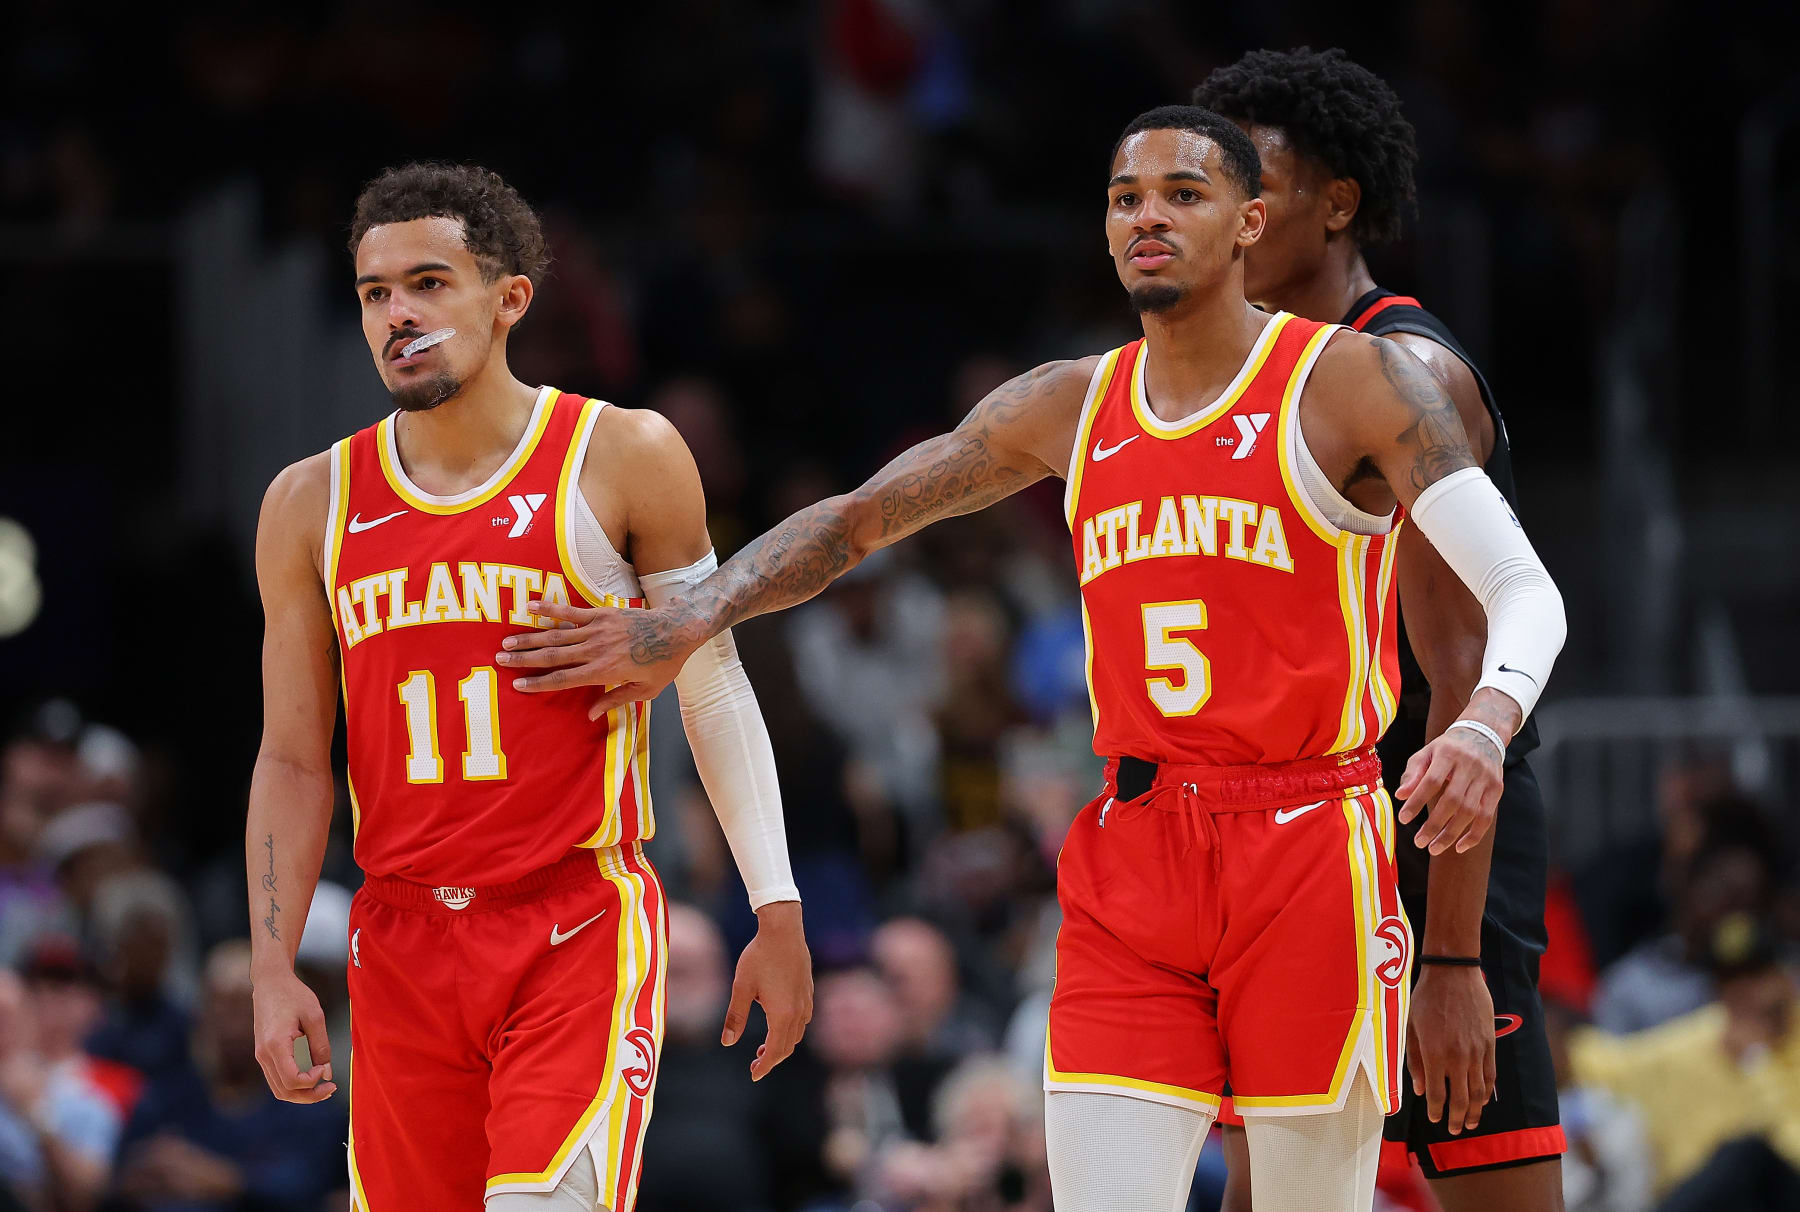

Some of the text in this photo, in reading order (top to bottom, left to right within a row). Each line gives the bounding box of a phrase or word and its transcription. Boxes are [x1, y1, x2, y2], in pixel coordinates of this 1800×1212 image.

[1215, 412, 1271, 460] the Y
[491, 493, 548, 538] the Y
[1080, 495, 1295, 588] ATLANTA
[1141, 599, 1212, 718] 5
[397, 665, 508, 785] 11
[432, 886, 476, 901] HAWKS
